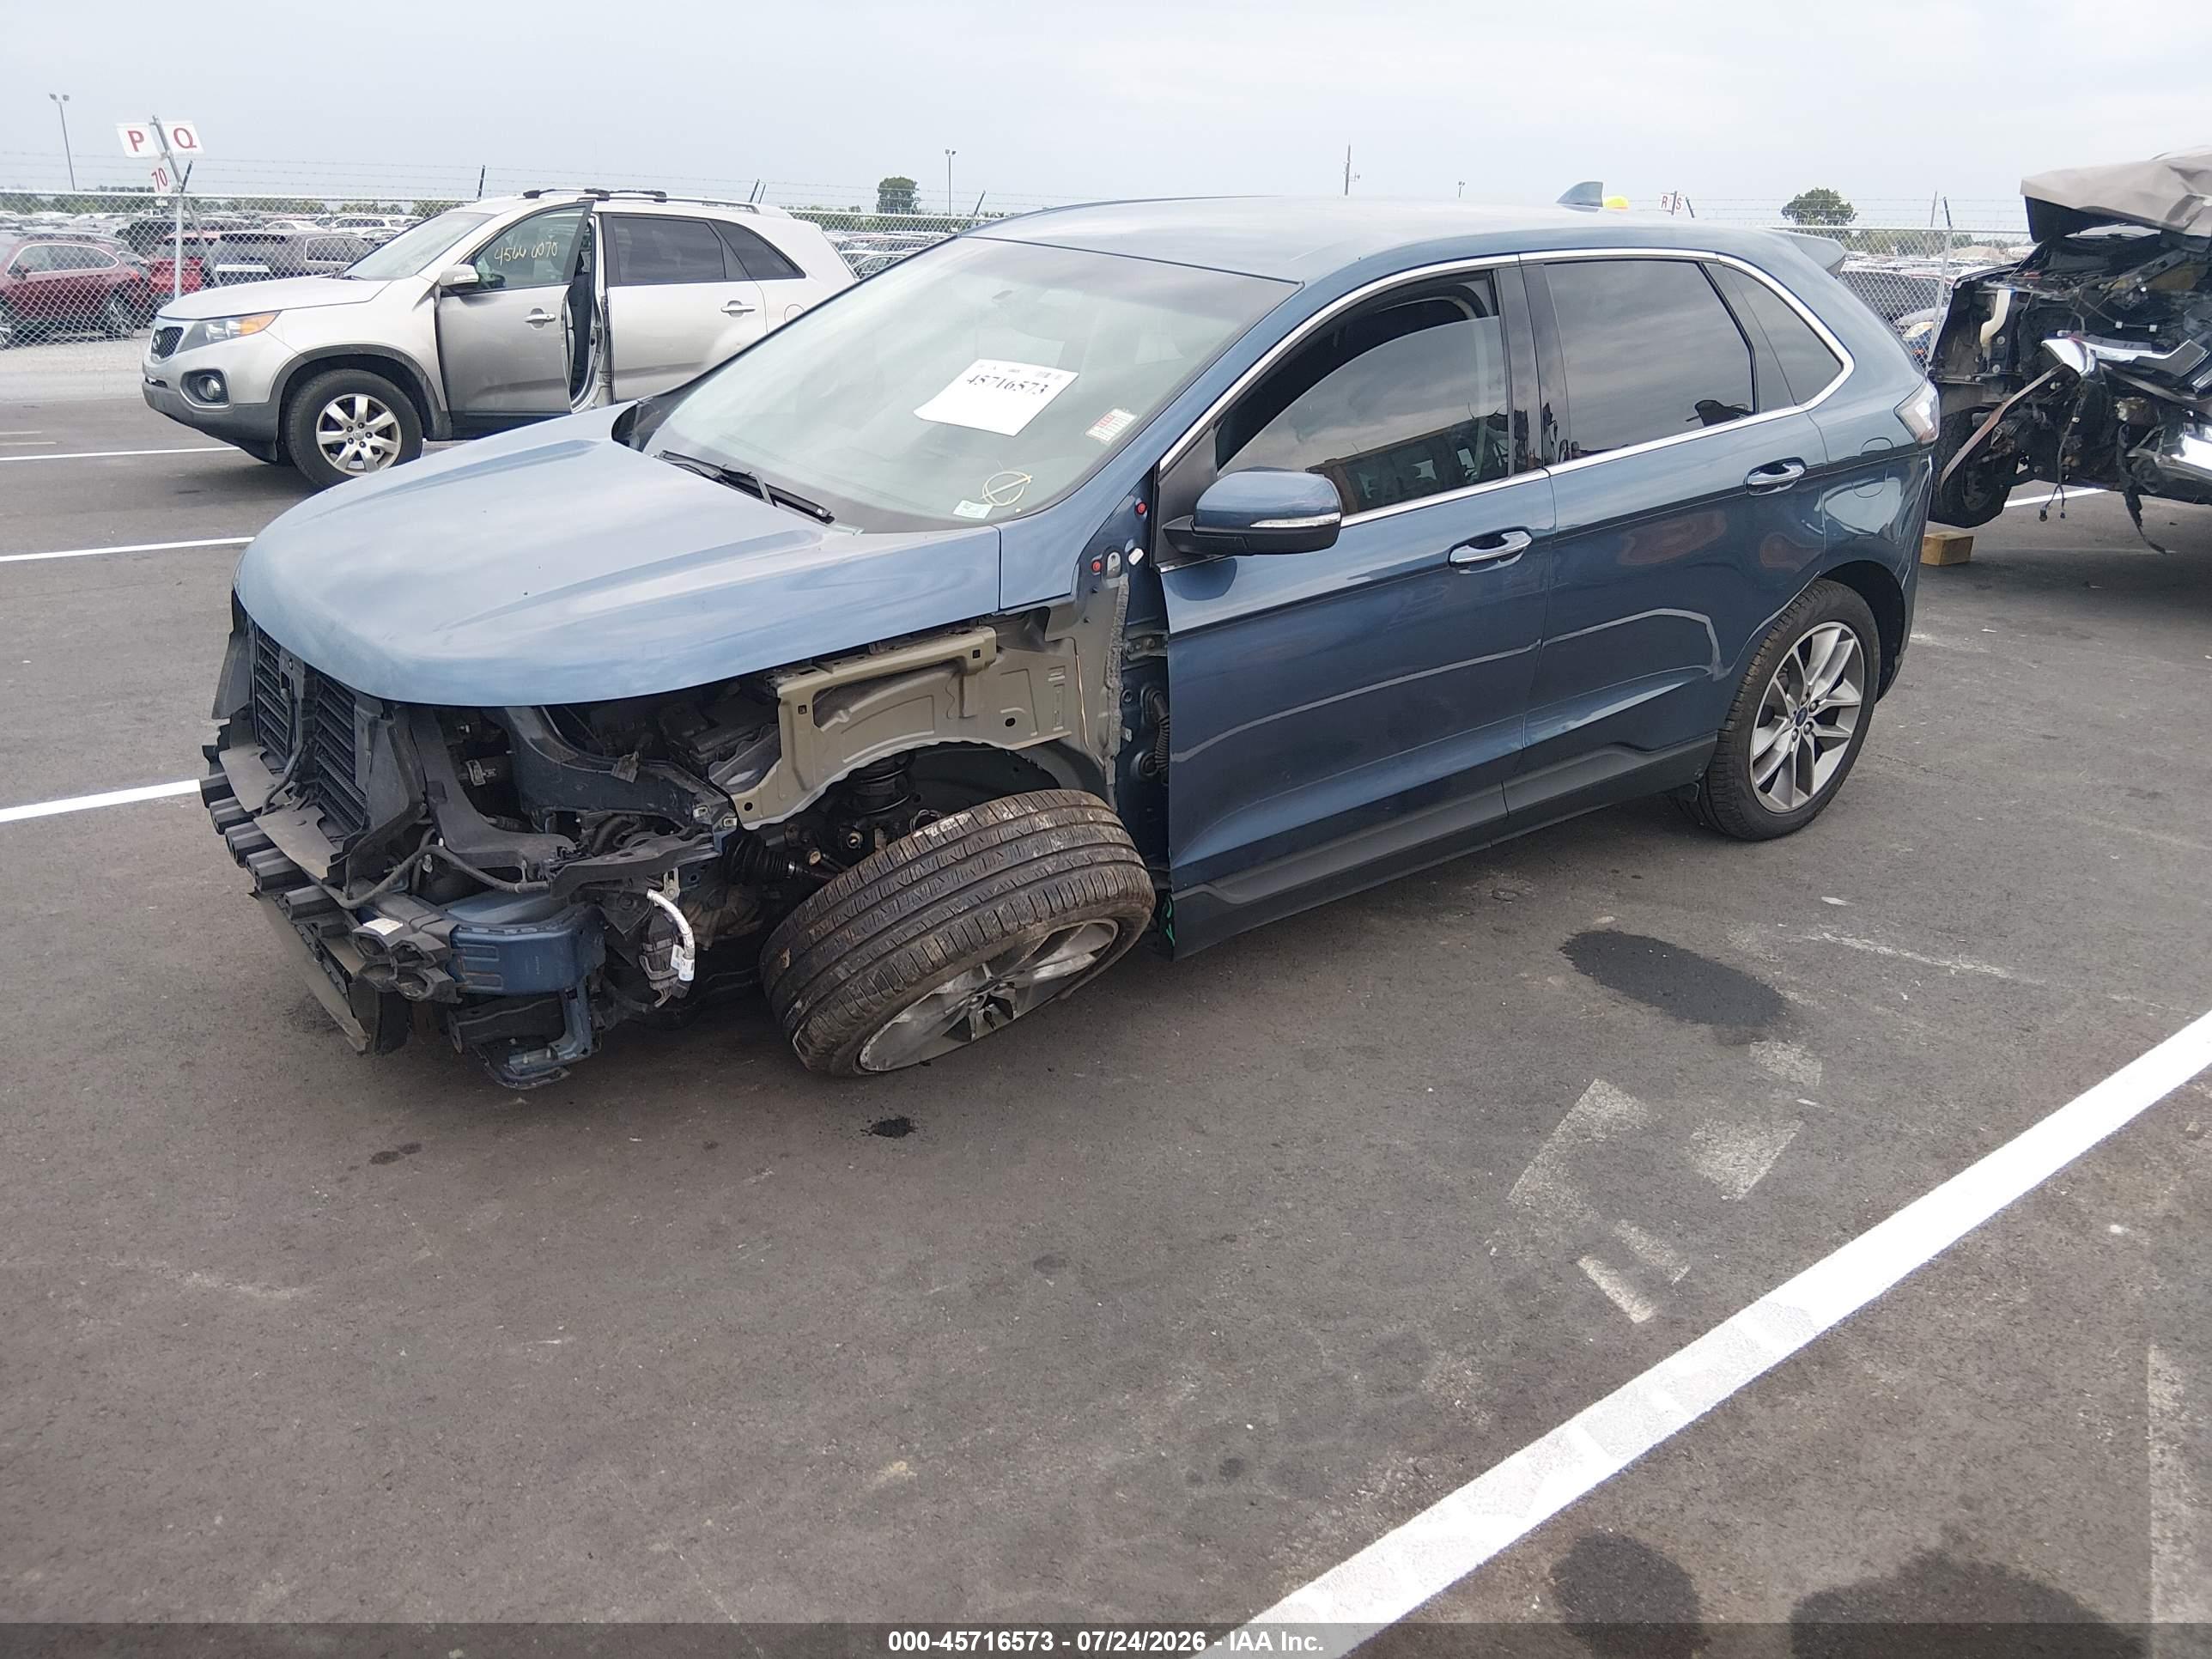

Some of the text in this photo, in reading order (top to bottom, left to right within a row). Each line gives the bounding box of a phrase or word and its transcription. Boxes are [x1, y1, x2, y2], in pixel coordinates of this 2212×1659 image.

[127, 130, 144, 152] P
[173, 127, 197, 149] Q
[151, 167, 168, 191] 70
[1661, 195, 1668, 209] R
[1675, 197, 1682, 210] S
